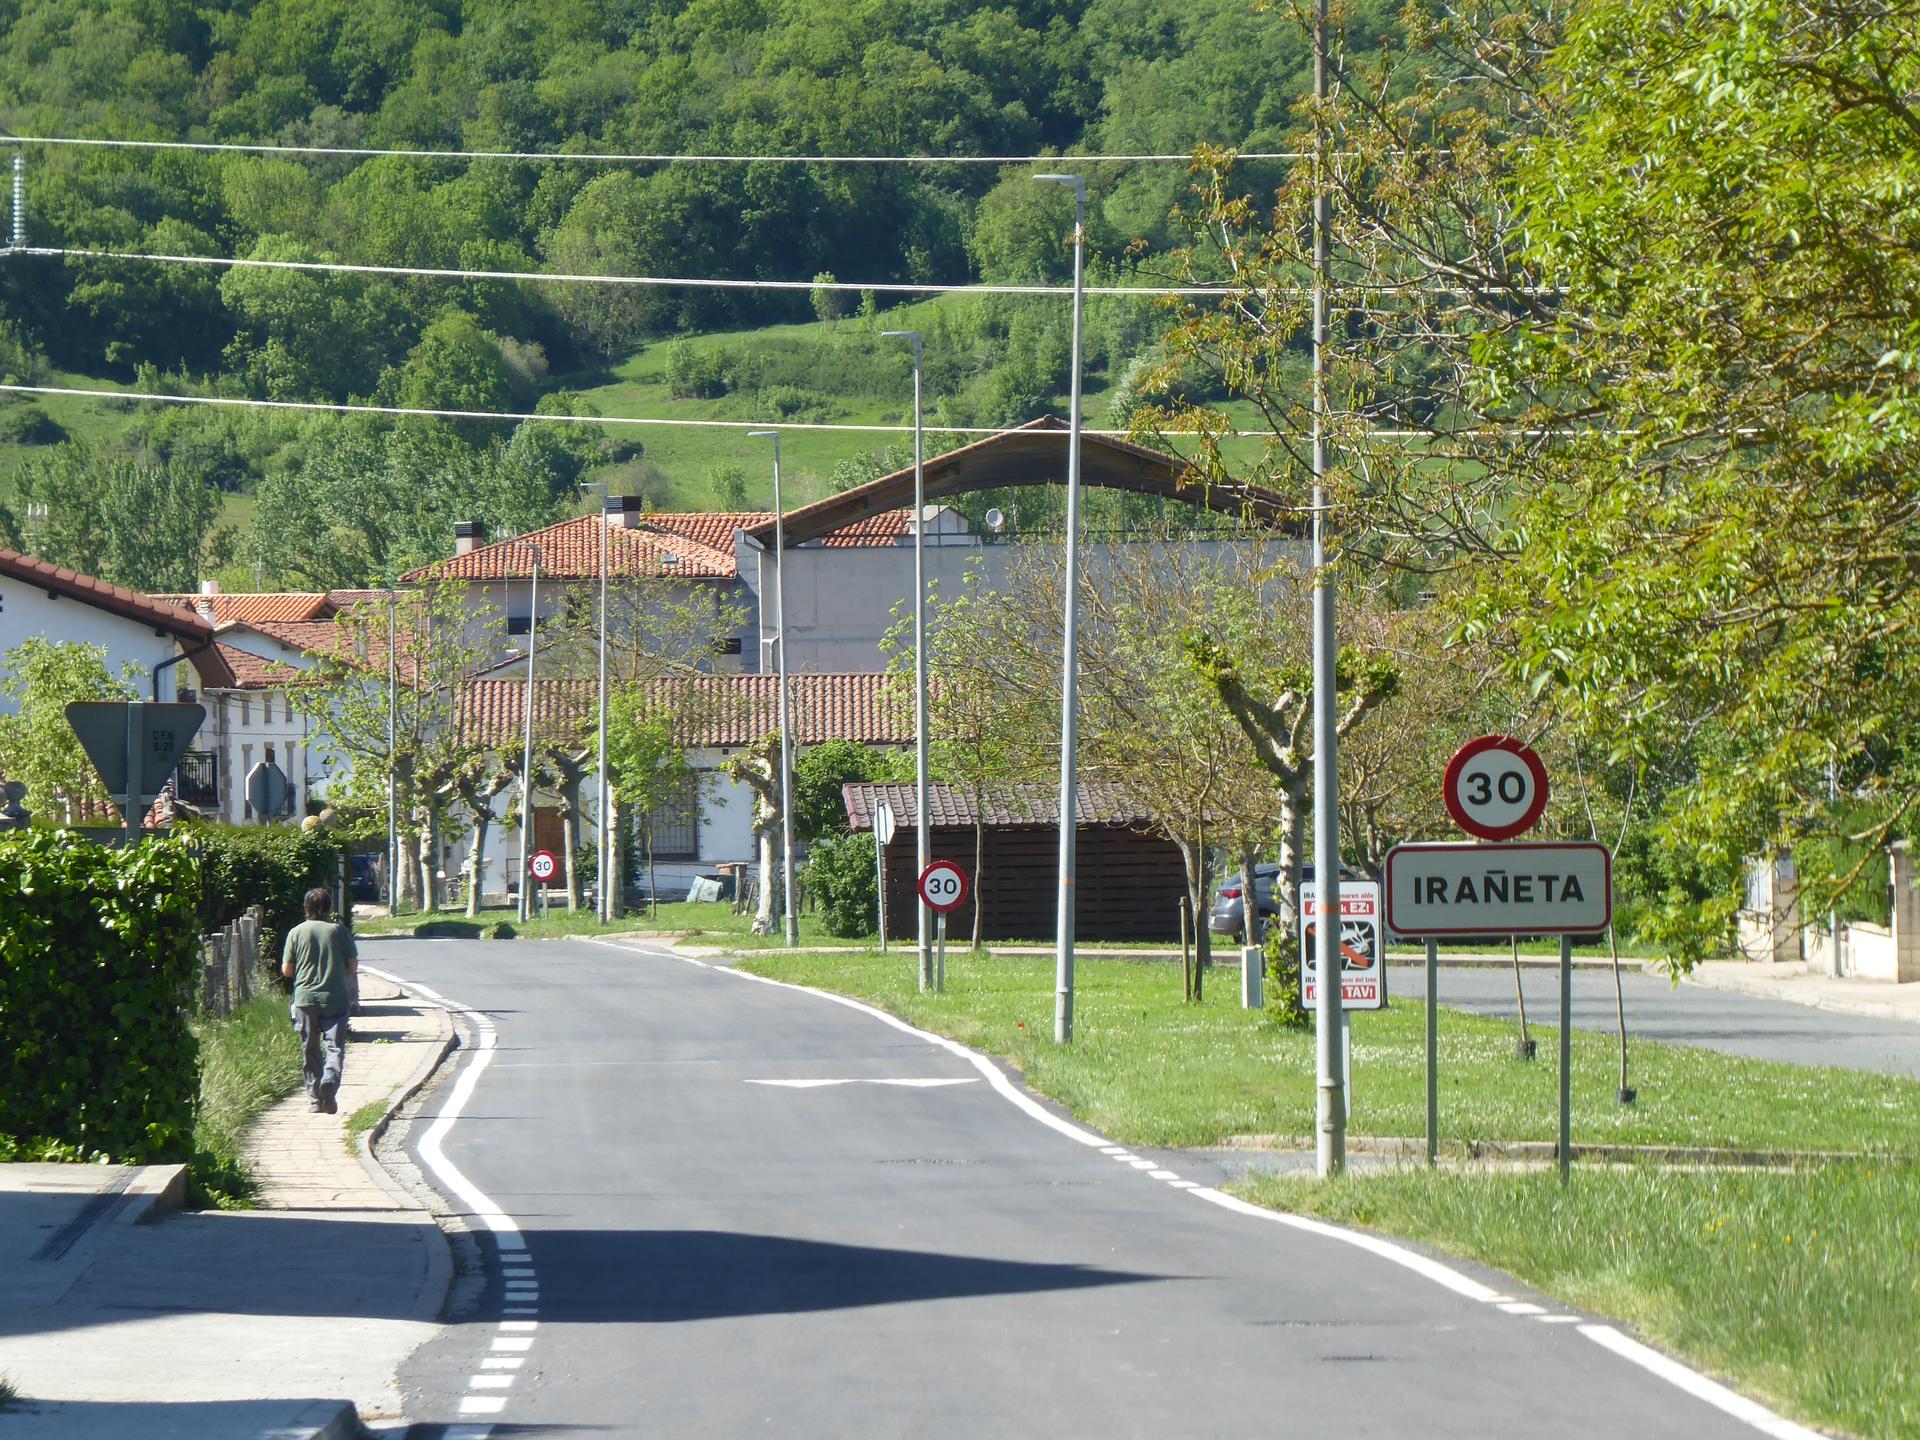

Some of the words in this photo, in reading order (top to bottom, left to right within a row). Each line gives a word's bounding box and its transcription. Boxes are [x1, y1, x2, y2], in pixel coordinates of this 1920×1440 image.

[1466, 771, 1526, 806] 30
[535, 861, 551, 871] 30
[929, 878, 958, 895] 30
[1414, 869, 1585, 905] IRAÑETA
[1350, 902, 1370, 913] EZ!
[1345, 986, 1374, 998] TAV!
